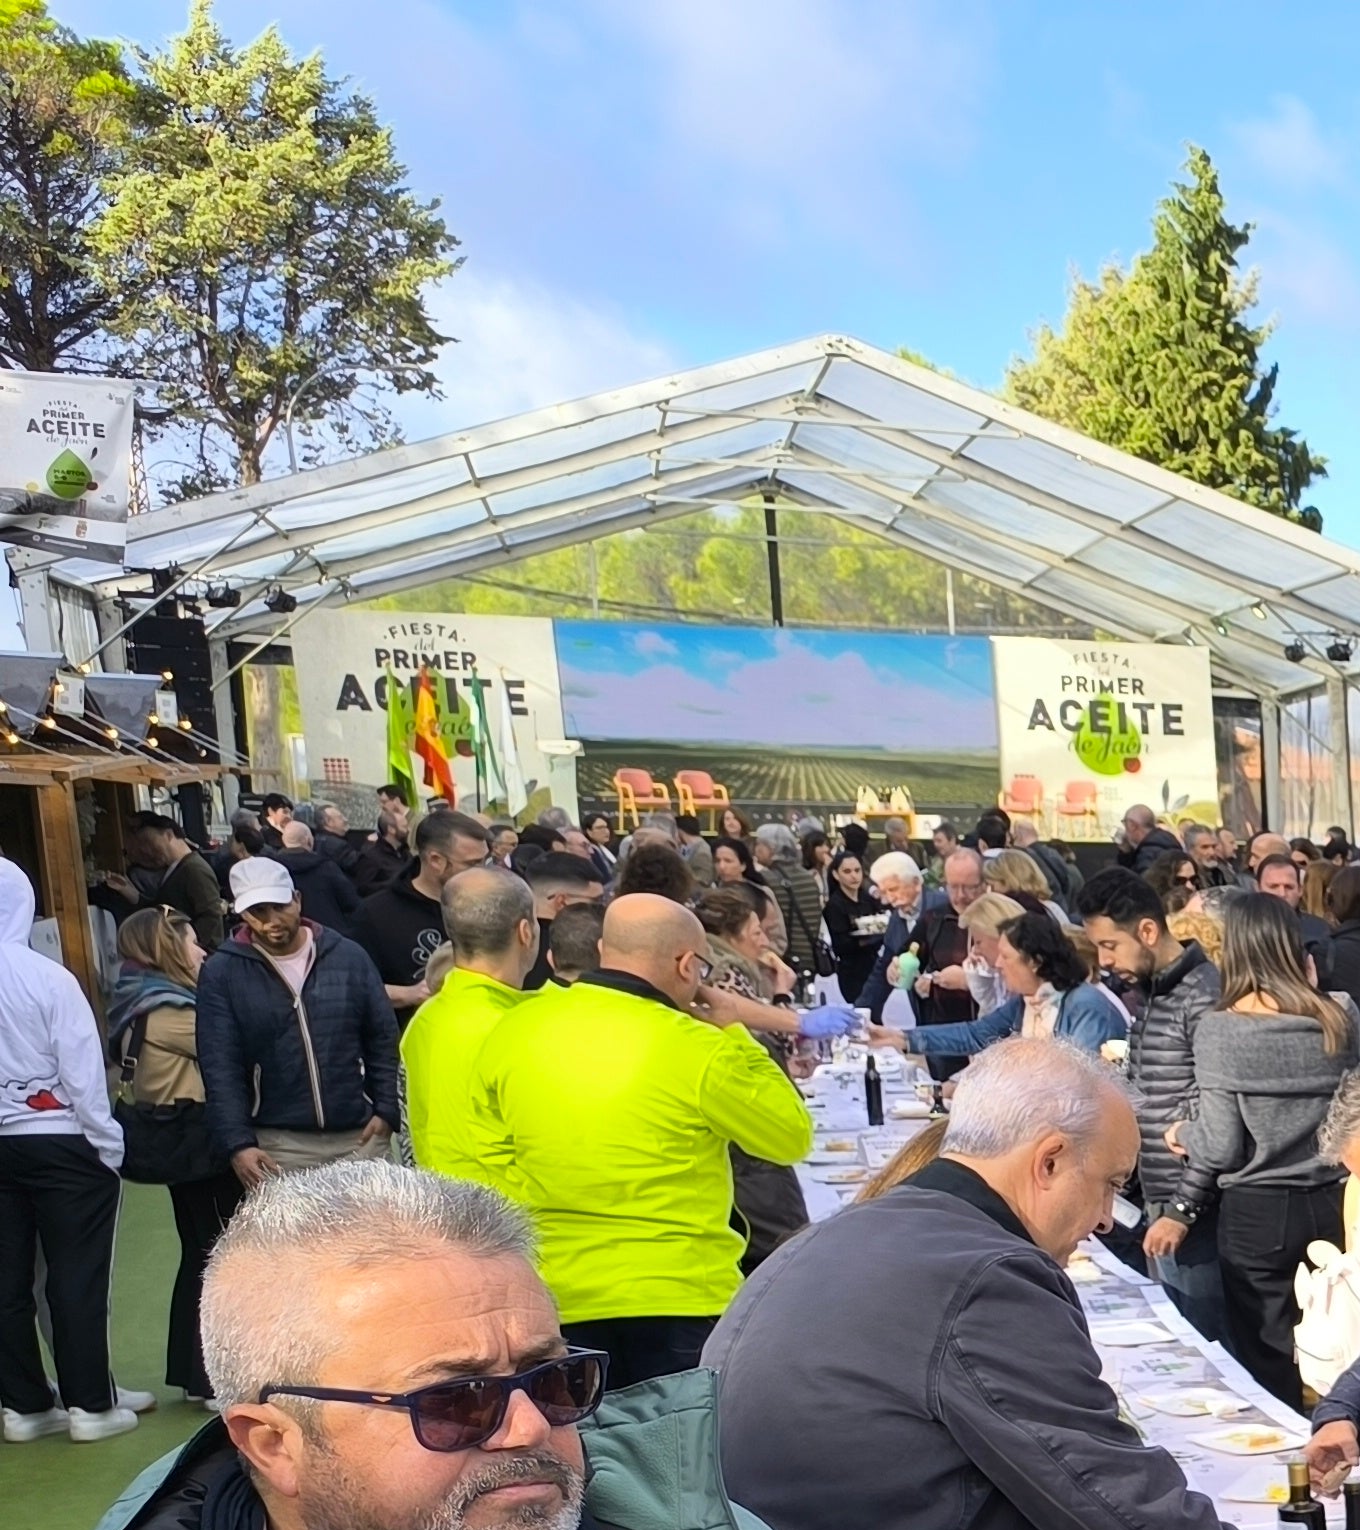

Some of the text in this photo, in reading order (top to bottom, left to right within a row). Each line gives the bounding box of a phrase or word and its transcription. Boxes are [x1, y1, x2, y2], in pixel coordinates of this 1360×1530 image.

[42, 409, 86, 420] PRIMER
[26, 418, 106, 438] ACEITE
[374, 648, 477, 671] PRIMER
[1060, 675, 1146, 696] PRIMER
[1027, 698, 1185, 736] ACEITE
